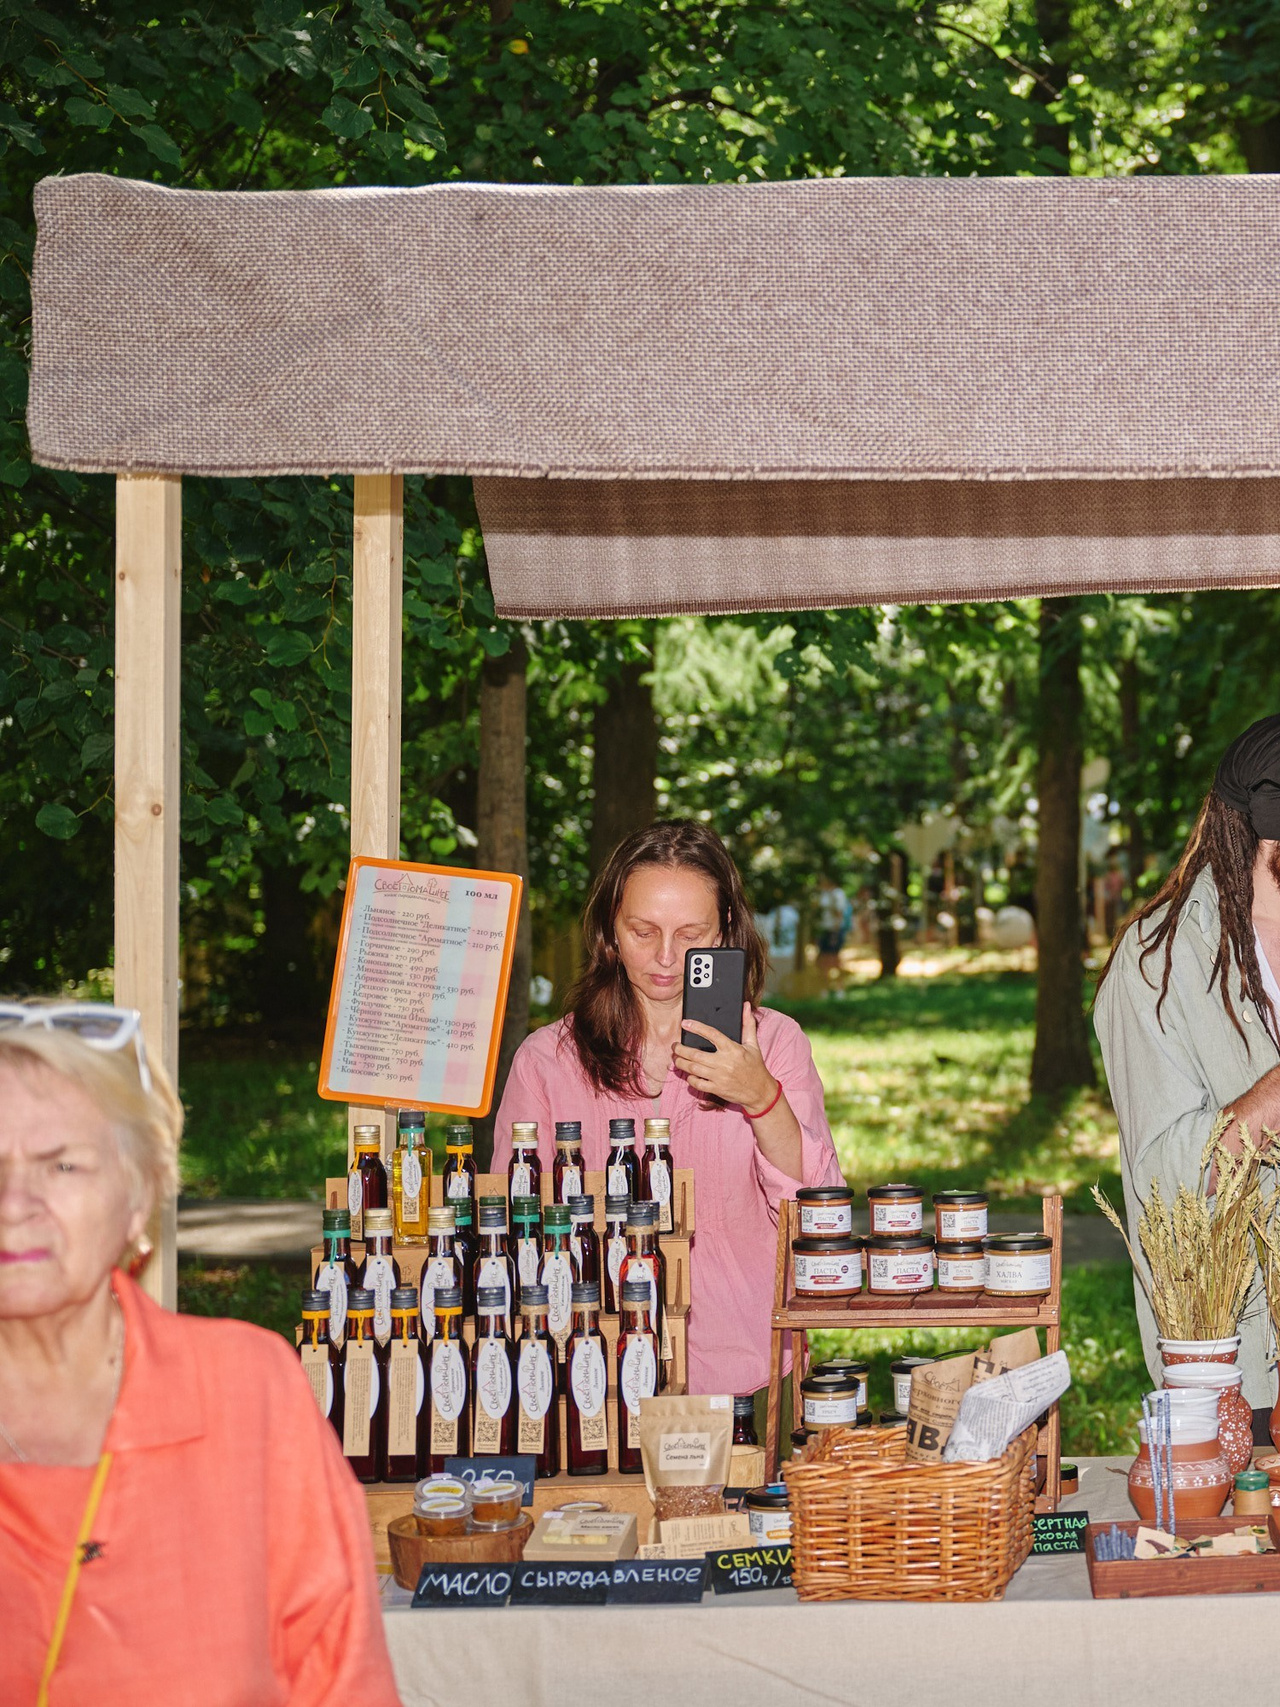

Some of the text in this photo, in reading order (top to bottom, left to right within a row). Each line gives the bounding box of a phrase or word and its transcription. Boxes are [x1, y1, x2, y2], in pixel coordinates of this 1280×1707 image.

[363, 904, 395, 915] Льняное
[415, 912, 430, 922] руб.
[363, 913, 418, 926] Подсолнечное
[489, 929, 504, 939] руб.
[361, 926, 416, 940] Подсолнечное
[484, 943, 500, 953] руб.
[360, 940, 400, 951] Горчичное
[421, 948, 436, 958] руб.
[357, 957, 402, 968] Конопляное
[424, 966, 439, 976] руб.
[408, 955, 423, 965] руб.
[354, 974, 404, 986] Абрикосовой
[460, 987, 475, 997] руб.
[422, 974, 436, 984] руб.
[352, 990, 387, 1000] Кедровое
[409, 997, 424, 1007] руб.
[353, 982, 388, 992] Грецкого
[390, 987, 411, 995] ореха
[431, 991, 446, 1001] руб.
[411, 1005, 425, 1016] руб.
[459, 1028, 475, 1038] руб.
[462, 1020, 477, 1030] руб.
[404, 1048, 419, 1058] руб.
[460, 1042, 475, 1052] руб.
[376, 1061, 391, 1072] руб.
[409, 1058, 424, 1068] руб.
[340, 1066, 379, 1077] Кокосовое
[399, 1074, 414, 1084] руб.
[420, 1571, 512, 1596] МАСЛО
